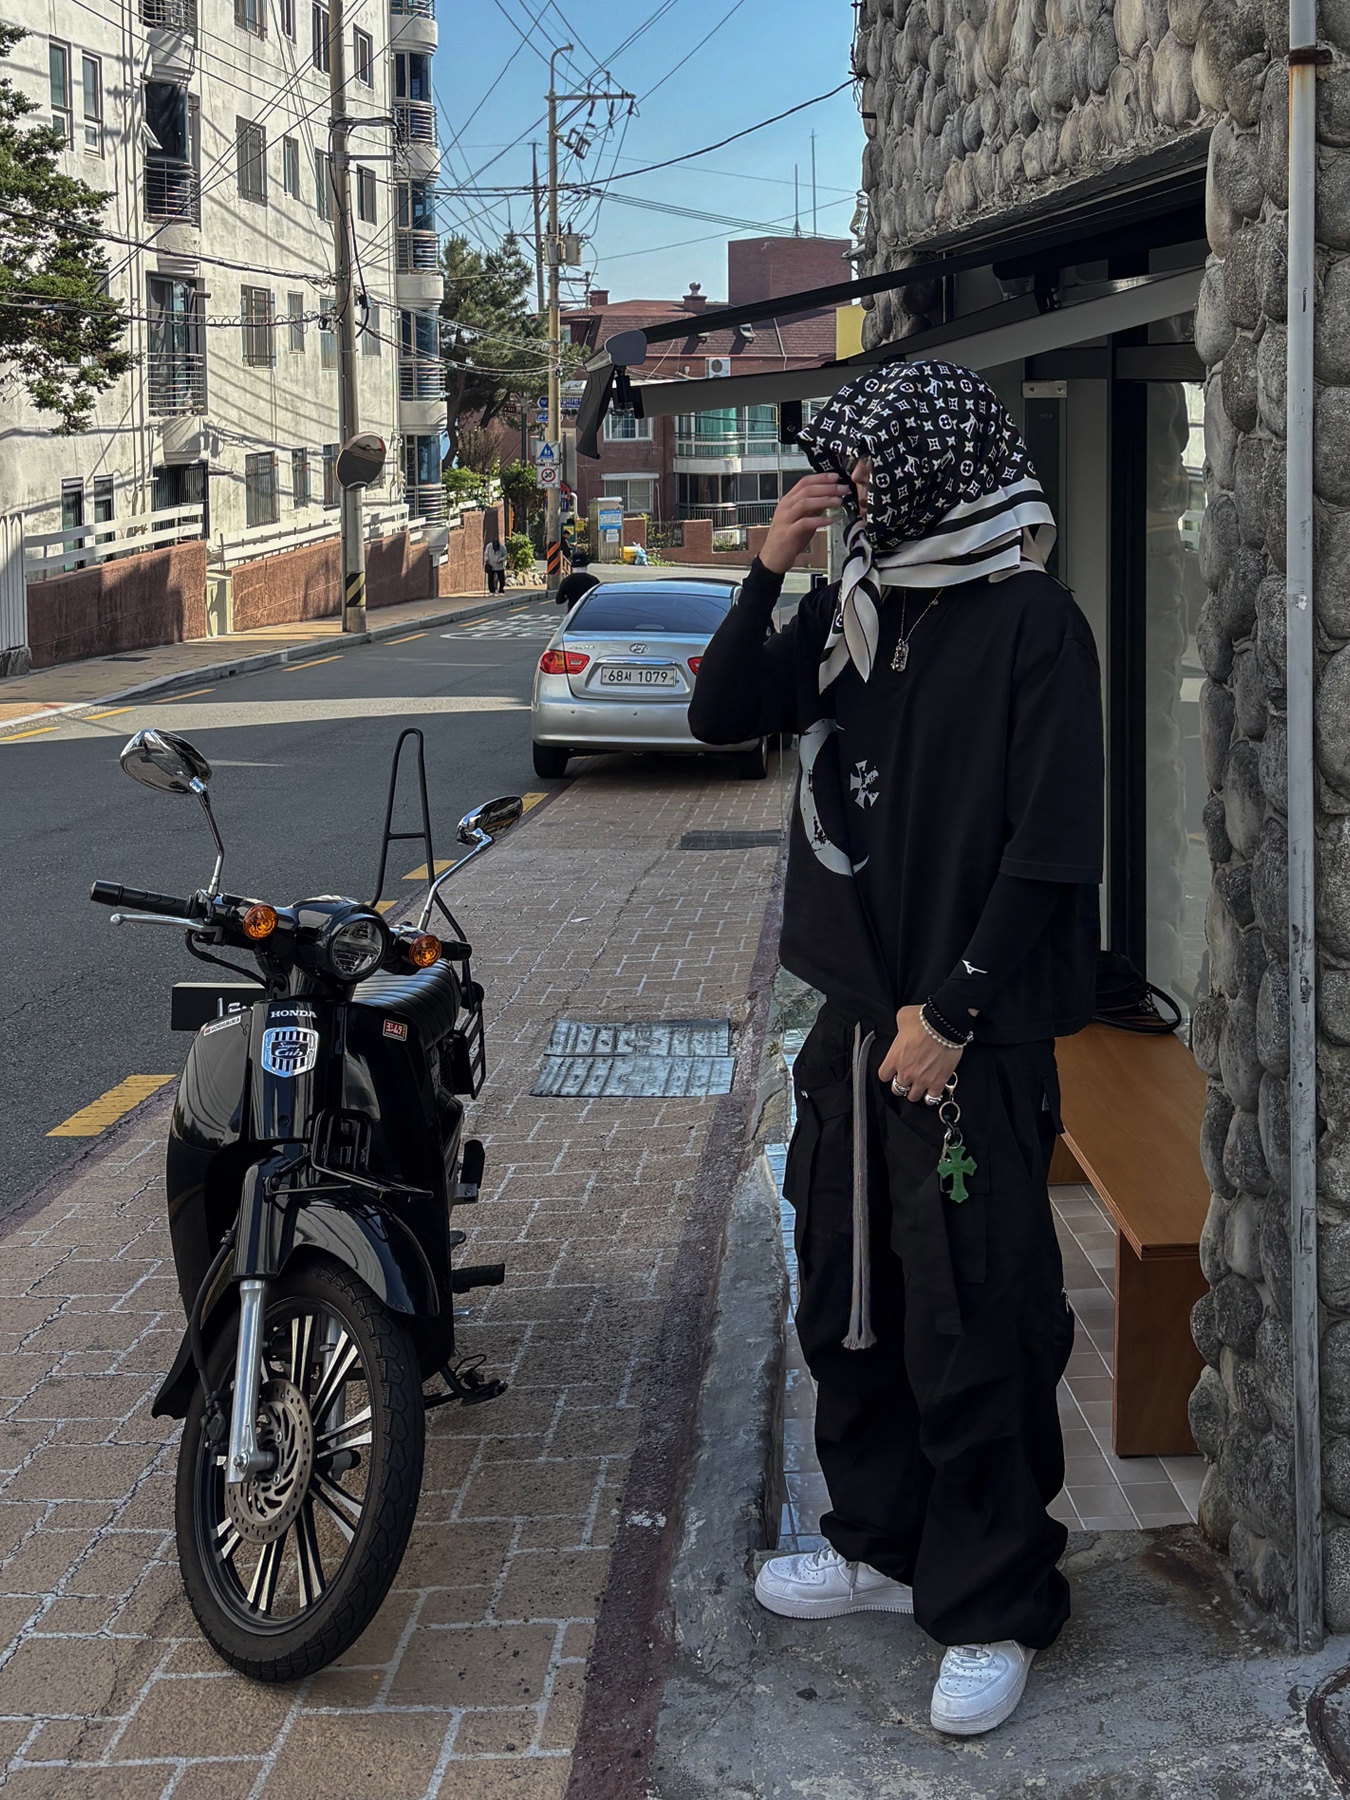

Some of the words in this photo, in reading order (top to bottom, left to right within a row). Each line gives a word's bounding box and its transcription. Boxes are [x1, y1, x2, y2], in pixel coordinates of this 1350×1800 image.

[608, 670, 631, 682] 68서
[638, 670, 668, 683] 1079
[270, 1009, 318, 1018] HONDA
[274, 1048, 303, 1057] Cub
